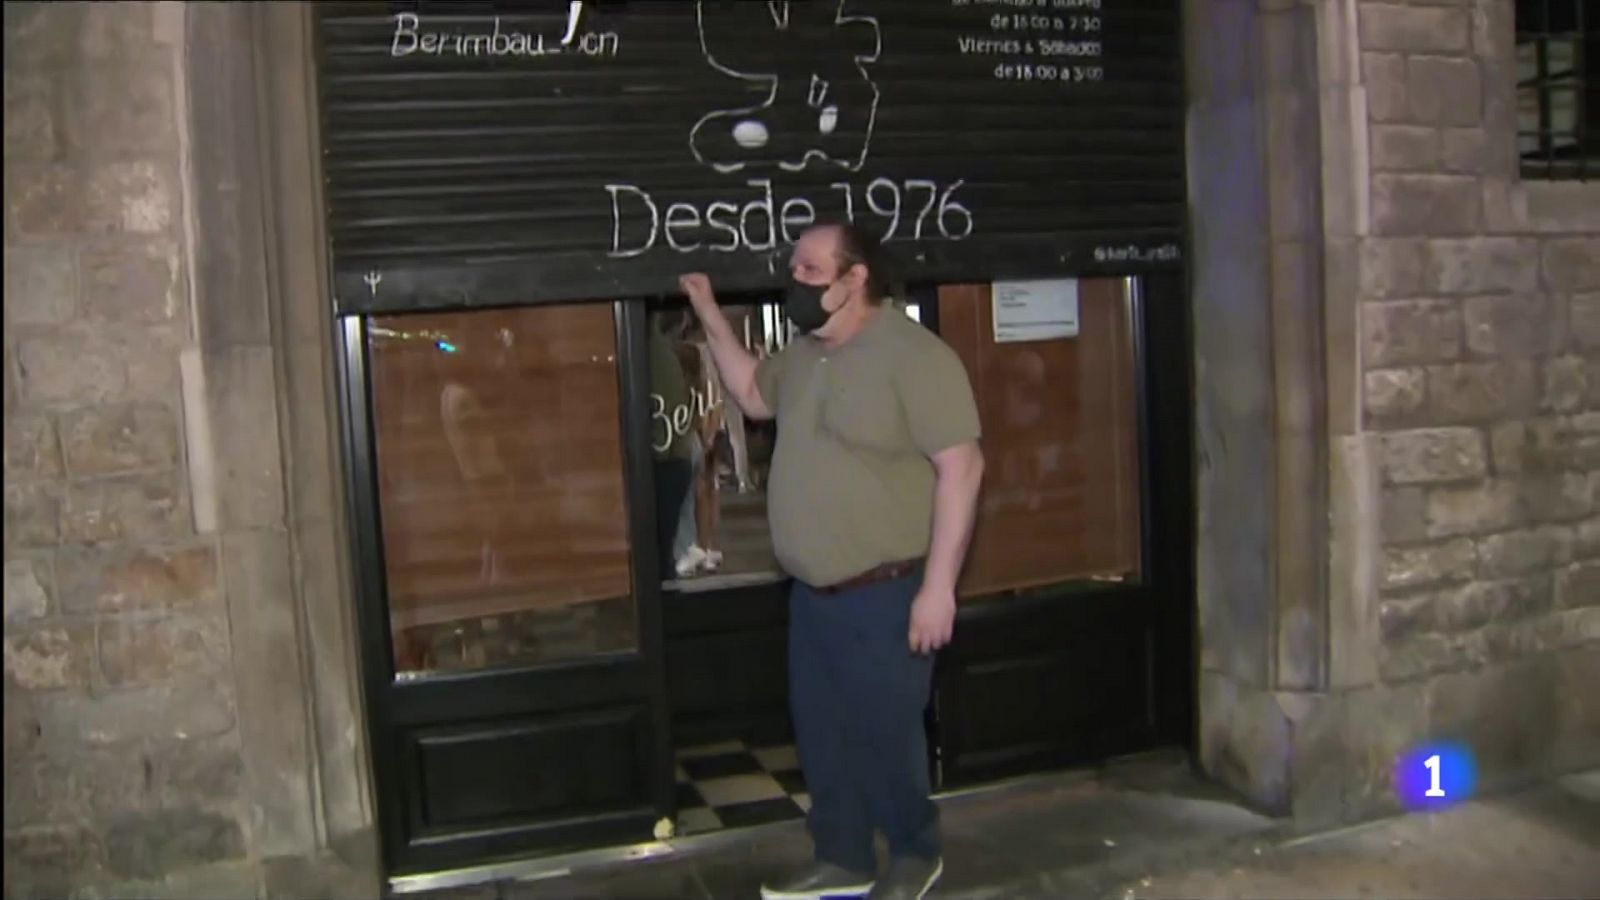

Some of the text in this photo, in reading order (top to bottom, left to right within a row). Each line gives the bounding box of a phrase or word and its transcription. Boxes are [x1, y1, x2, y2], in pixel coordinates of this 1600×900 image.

[994, 63, 1013, 79] de
[605, 177, 973, 257] Desde 1976
